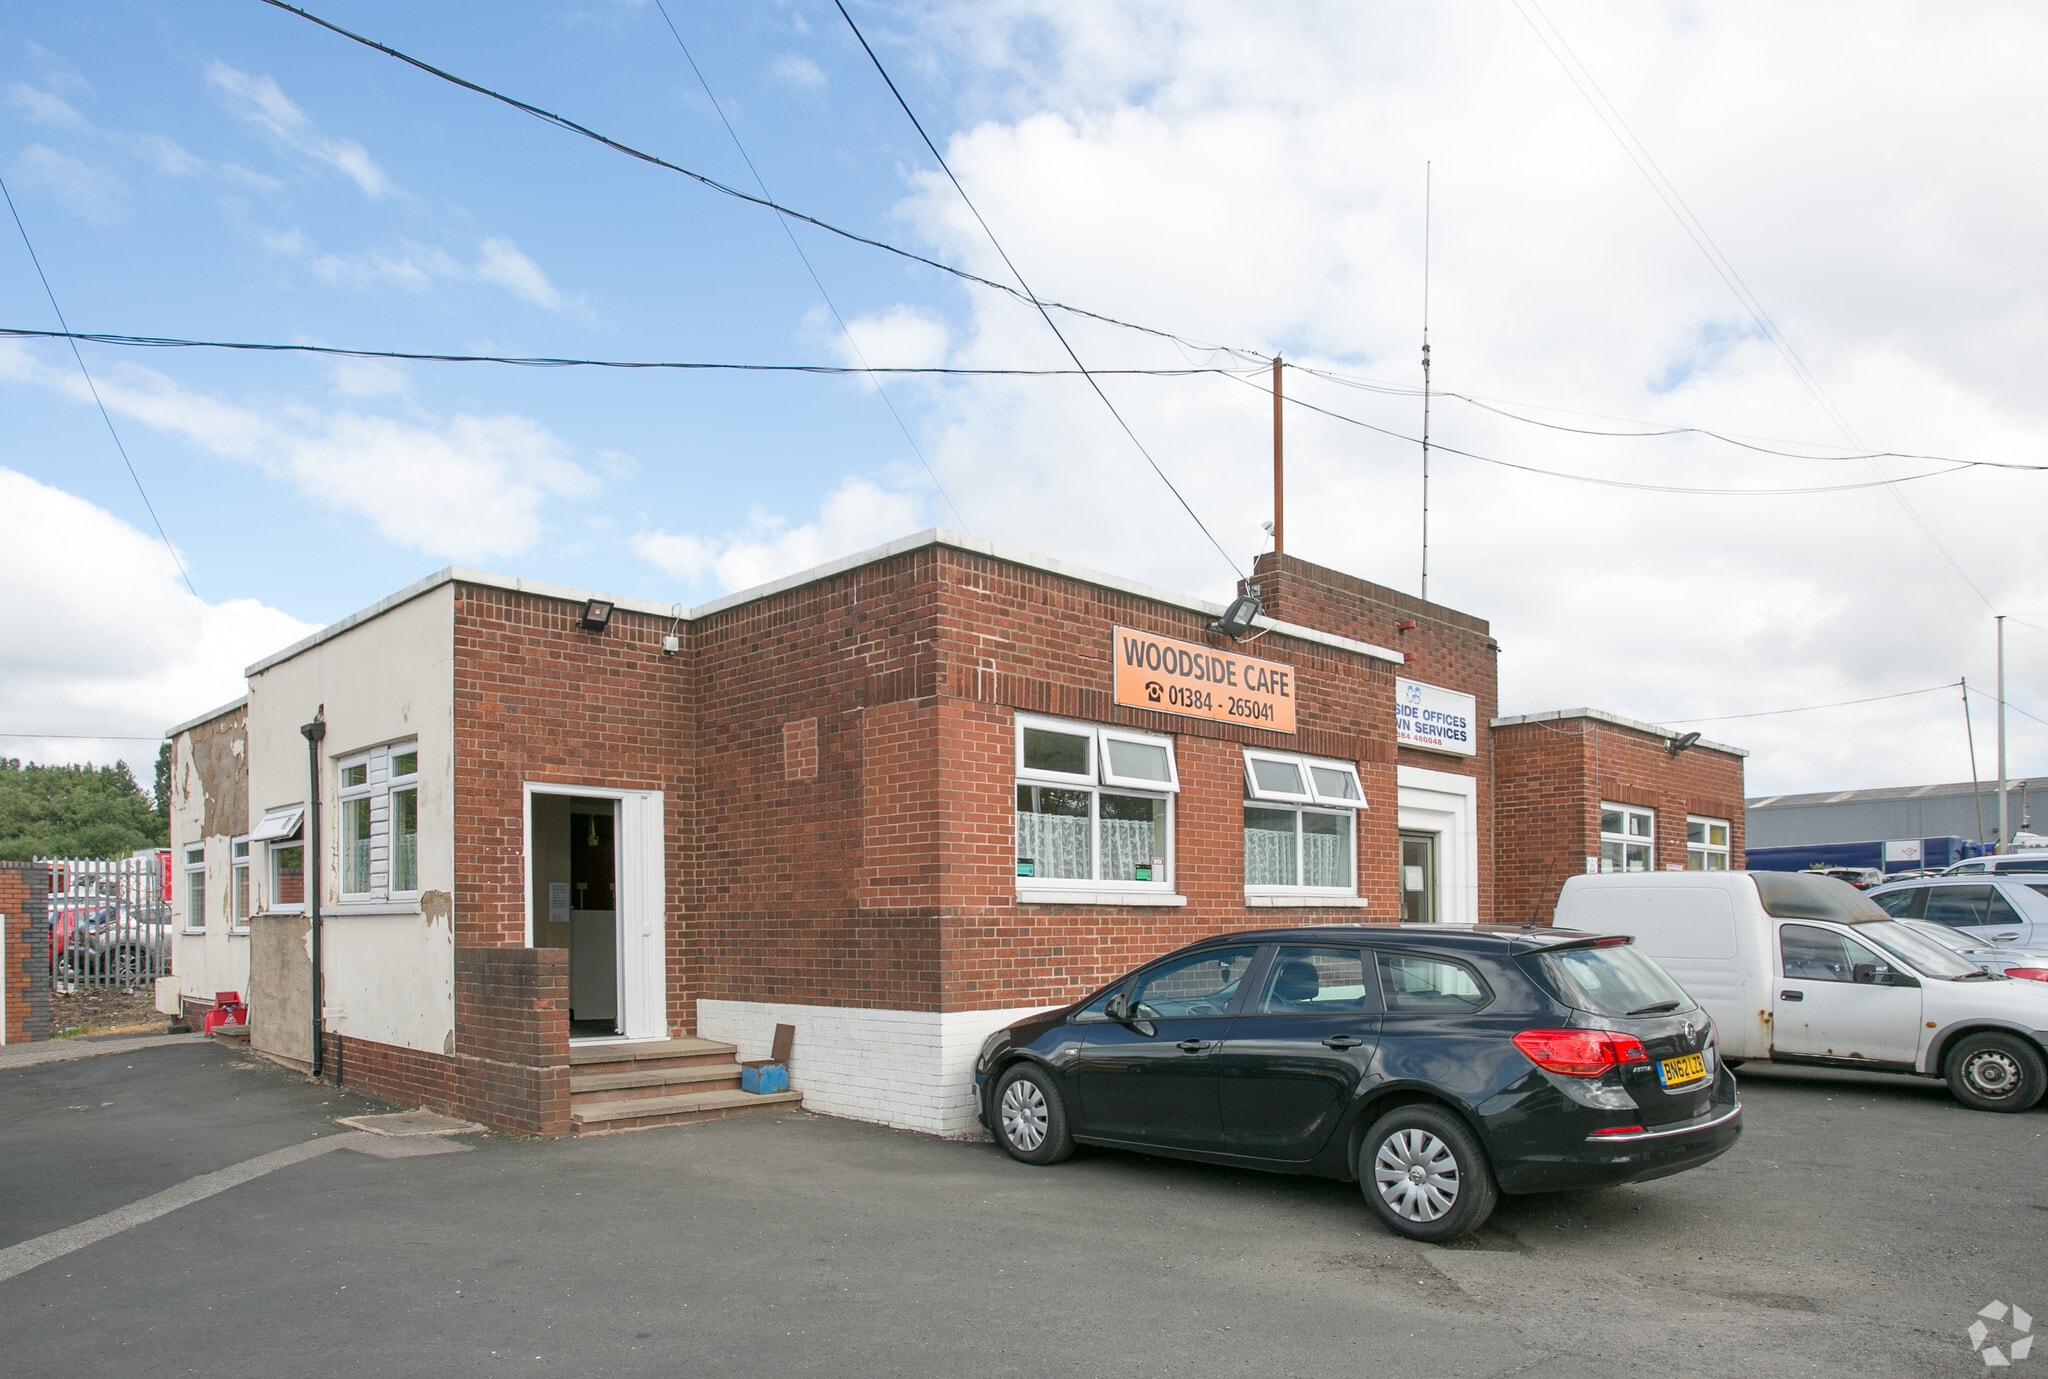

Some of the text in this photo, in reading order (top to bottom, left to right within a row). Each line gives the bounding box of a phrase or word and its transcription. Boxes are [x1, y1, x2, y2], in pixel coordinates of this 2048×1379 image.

[1123, 636, 1290, 698] WOODSIDE CAFE
[1168, 685, 1213, 712] 01384
[1228, 696, 1274, 722] 265041
[1396, 703, 1467, 729] SIDE OFFICES
[1414, 721, 1467, 742] SERVICES
[1663, 1059, 1690, 1081] BN62
